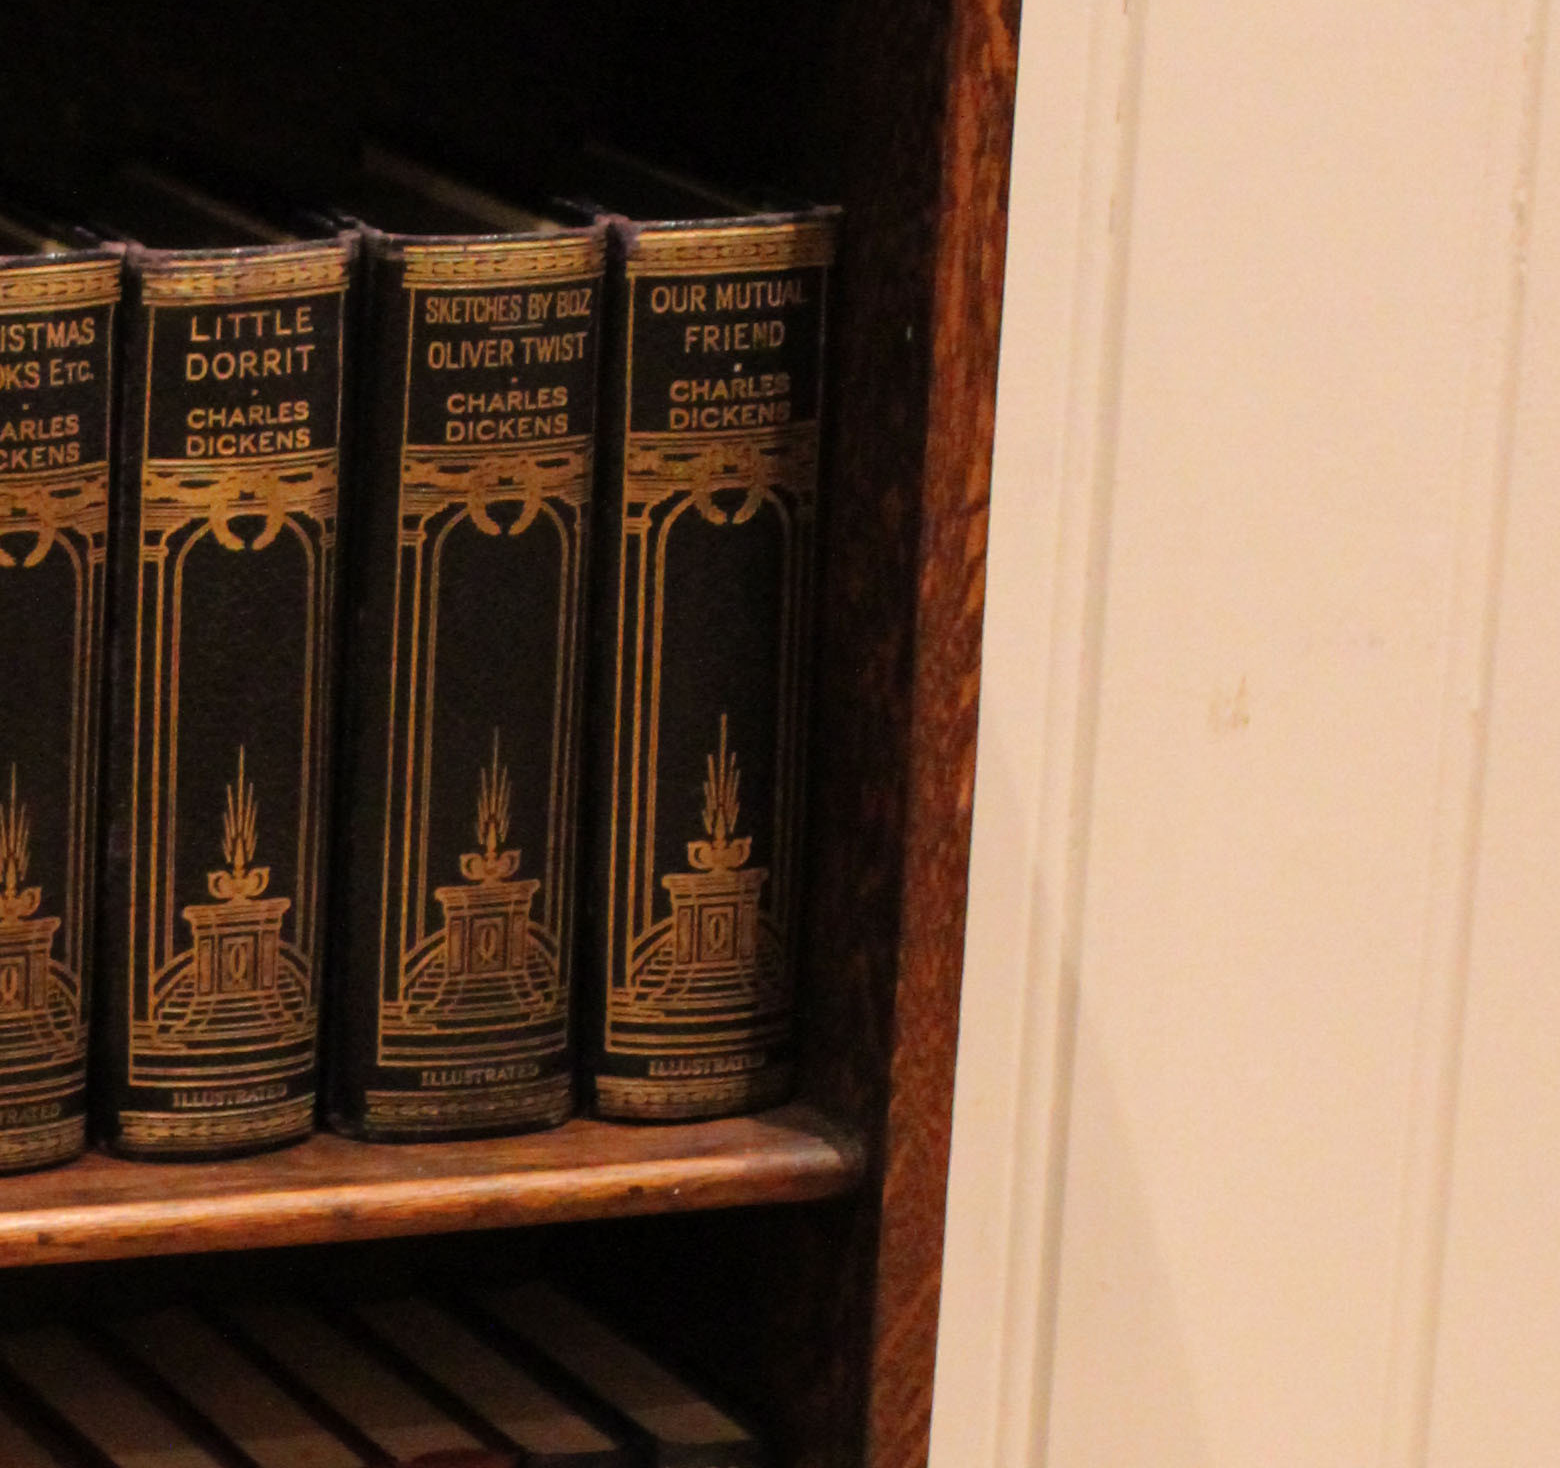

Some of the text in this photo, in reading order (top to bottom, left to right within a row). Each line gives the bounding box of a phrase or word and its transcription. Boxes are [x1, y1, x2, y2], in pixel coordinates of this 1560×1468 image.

[425, 288, 592, 323] SKETCHES BY BOZ
[650, 280, 808, 314] OUR MUTUAL
[189, 307, 312, 341] LITTLE
[684, 322, 784, 354] FRIEND
[186, 346, 315, 381] DORRIT
[428, 332, 588, 369] OLIVER TWIST
[446, 386, 568, 414] CHARLES
[669, 374, 790, 402] CHARLES
[187, 401, 309, 429] CHARLES
[446, 414, 568, 442] DICKENS
[668, 402, 791, 430] DICKENS
[186, 429, 310, 457] DICKENS
[172, 1083, 288, 1108] ILLUSTRATED
